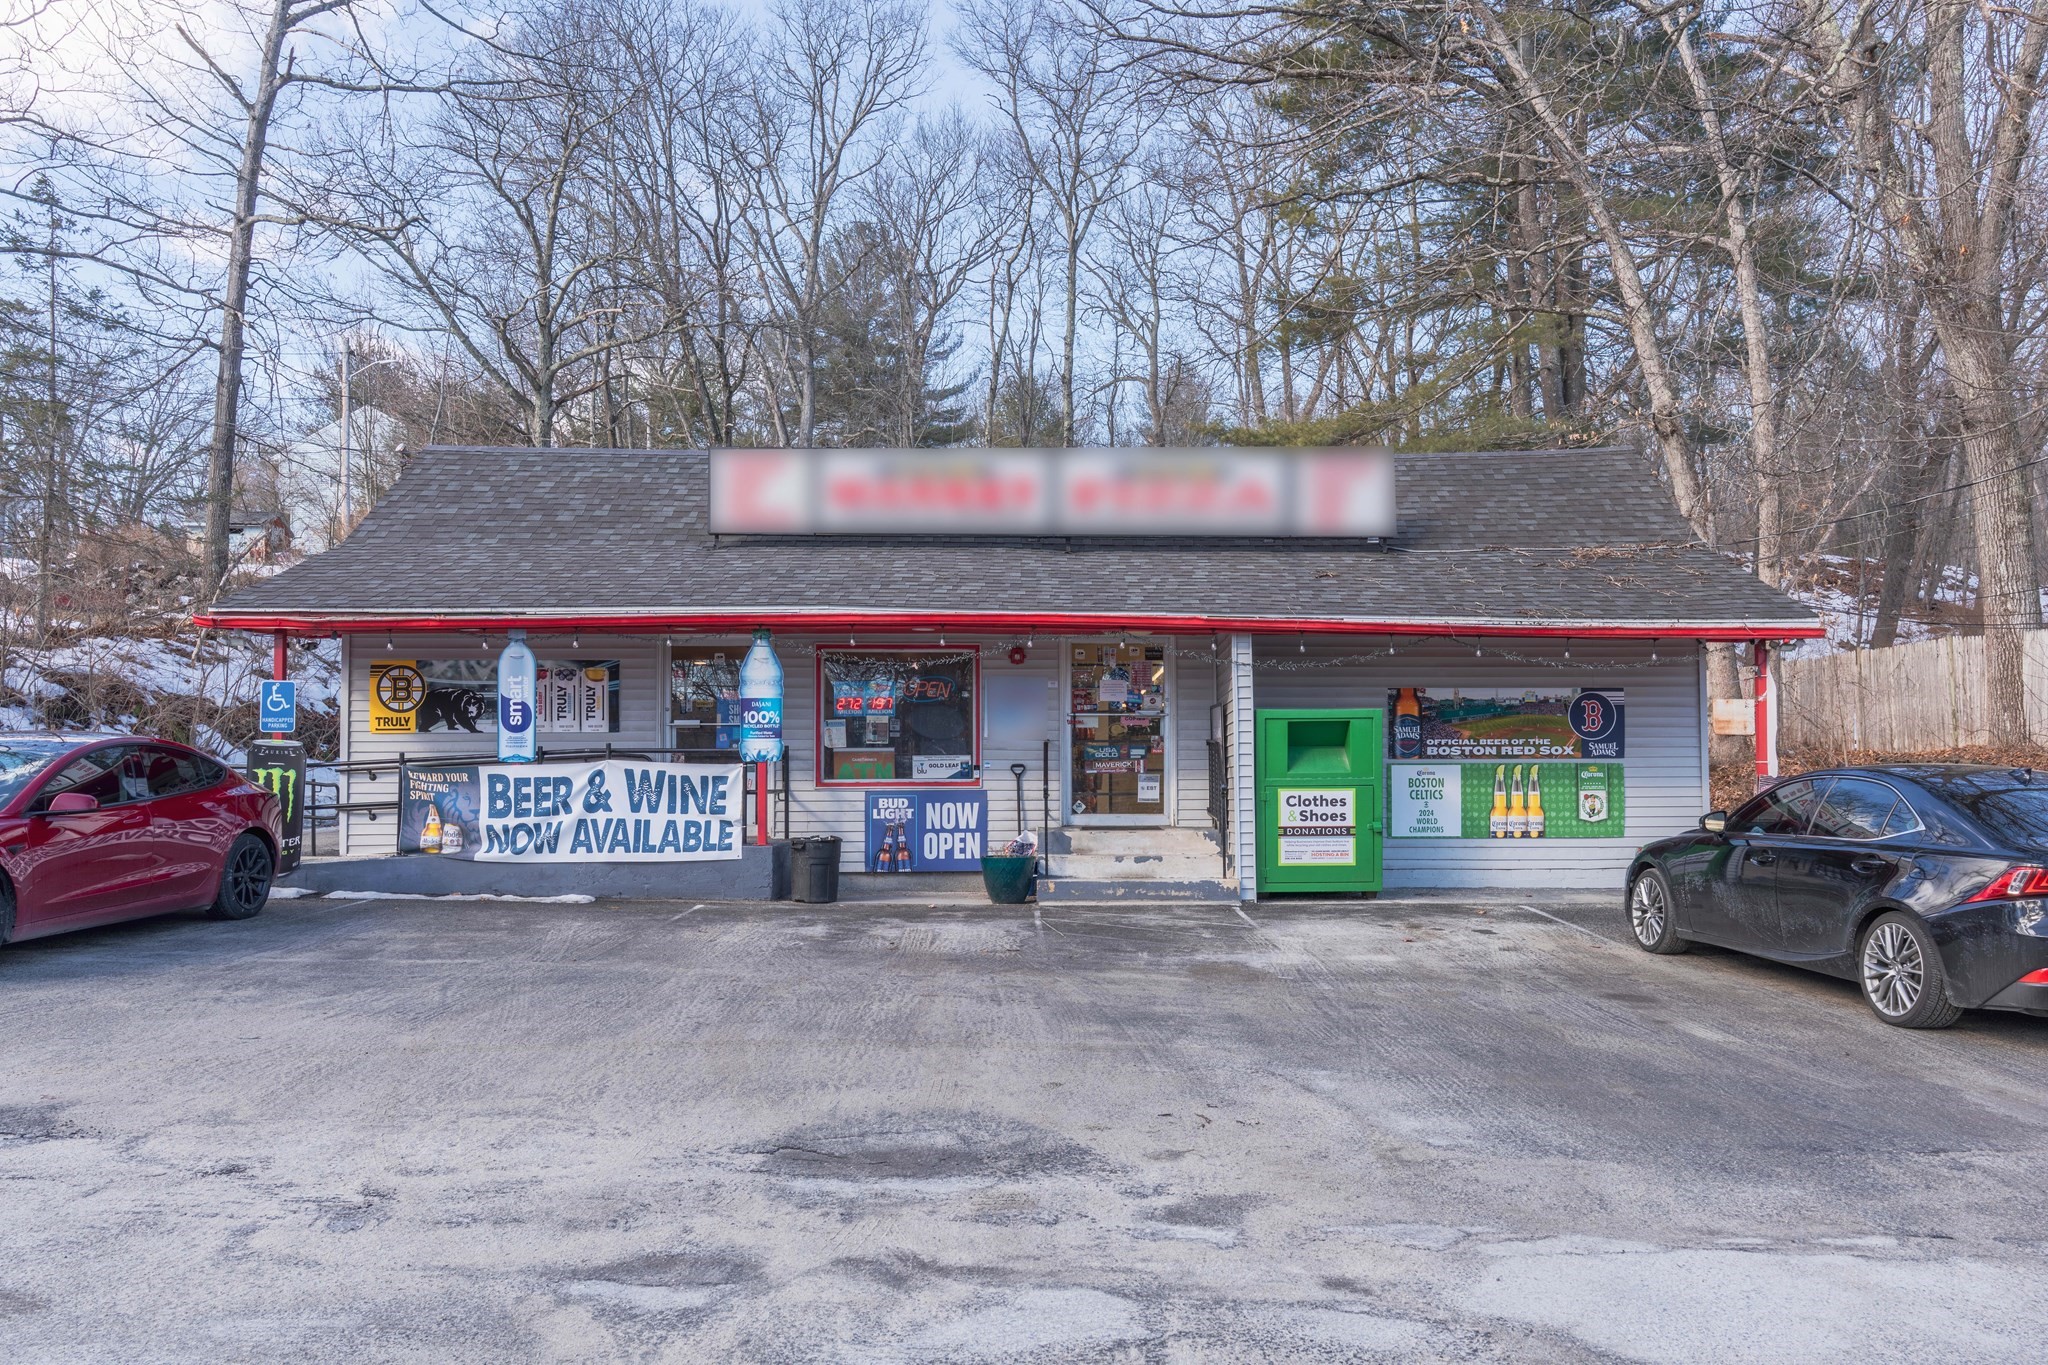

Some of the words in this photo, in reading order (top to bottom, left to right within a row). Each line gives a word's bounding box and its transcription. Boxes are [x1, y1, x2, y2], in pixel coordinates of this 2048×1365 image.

[904, 681, 951, 698] OPEN
[508, 676, 522, 726] smart
[557, 686, 566, 721] TRULY
[586, 686, 596, 720] TRULY
[836, 698, 862, 710] 272
[376, 717, 410, 727] TRULY
[743, 711, 780, 724] 100%
[1581, 700, 1603, 732] B
[1427, 746, 1499, 756] BOSTON
[1501, 746, 1537, 755] RED
[1540, 746, 1574, 755] SOX
[1589, 741, 1619, 750] SAMUEL
[838, 762, 894, 779] ATM
[917, 766, 928, 774] blu
[445, 773, 469, 782] YOUR
[1408, 778, 1444, 788] BOSTON
[487, 774, 573, 819] BEER
[583, 768, 612, 814] &
[624, 768, 730, 815] WINE
[1410, 790, 1443, 800] CELTICS
[879, 798, 908, 808] BUD
[1286, 795, 1346, 807] Clothes
[873, 809, 914, 819] LIGHT
[926, 802, 979, 829] NOW
[1288, 810, 1297, 822] &
[1300, 810, 1346, 822] Shoes
[483, 821, 563, 855] NOW
[569, 818, 734, 854] AVAILABLE
[924, 832, 980, 859] OPEN
